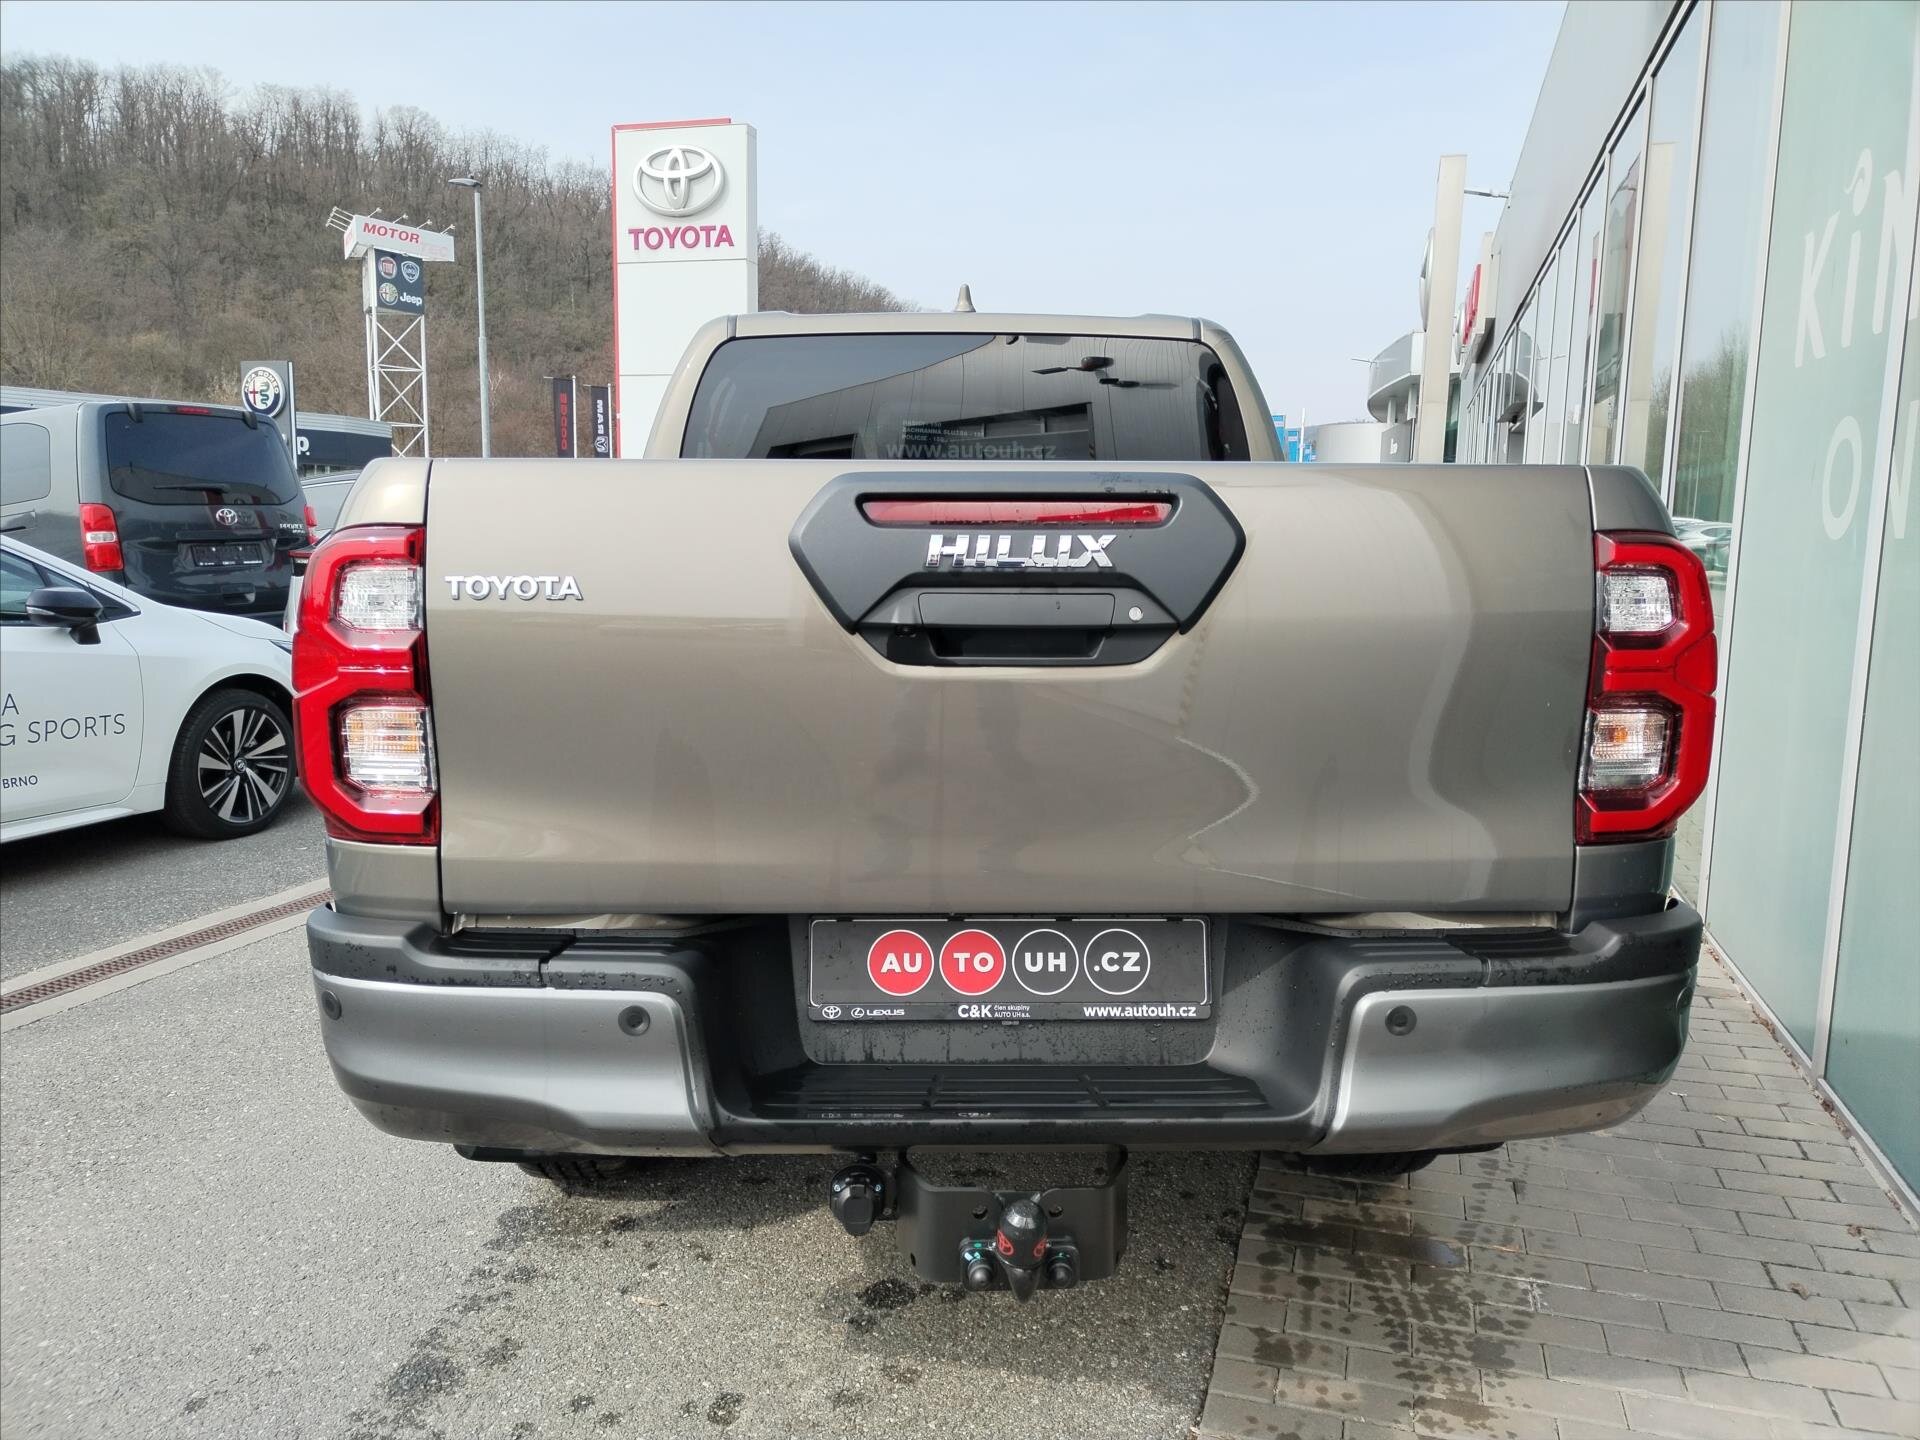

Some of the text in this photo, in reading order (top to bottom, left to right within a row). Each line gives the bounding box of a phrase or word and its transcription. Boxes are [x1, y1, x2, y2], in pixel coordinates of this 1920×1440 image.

[362, 223, 420, 244] MOTOR
[628, 225, 735, 250] TOYOTA
[400, 292, 423, 306] Jeep
[886, 441, 1057, 459] www.autouh.cz
[925, 534, 1117, 568] HILUX
[444, 575, 584, 601] TOYOTA
[2, 693, 20, 716] A
[0, 713, 126, 746] G SPORTS
[2, 775, 39, 789] BRNO
[957, 1004, 993, 1018] C&K
[1083, 1003, 1197, 1017] www.autouh.cz
